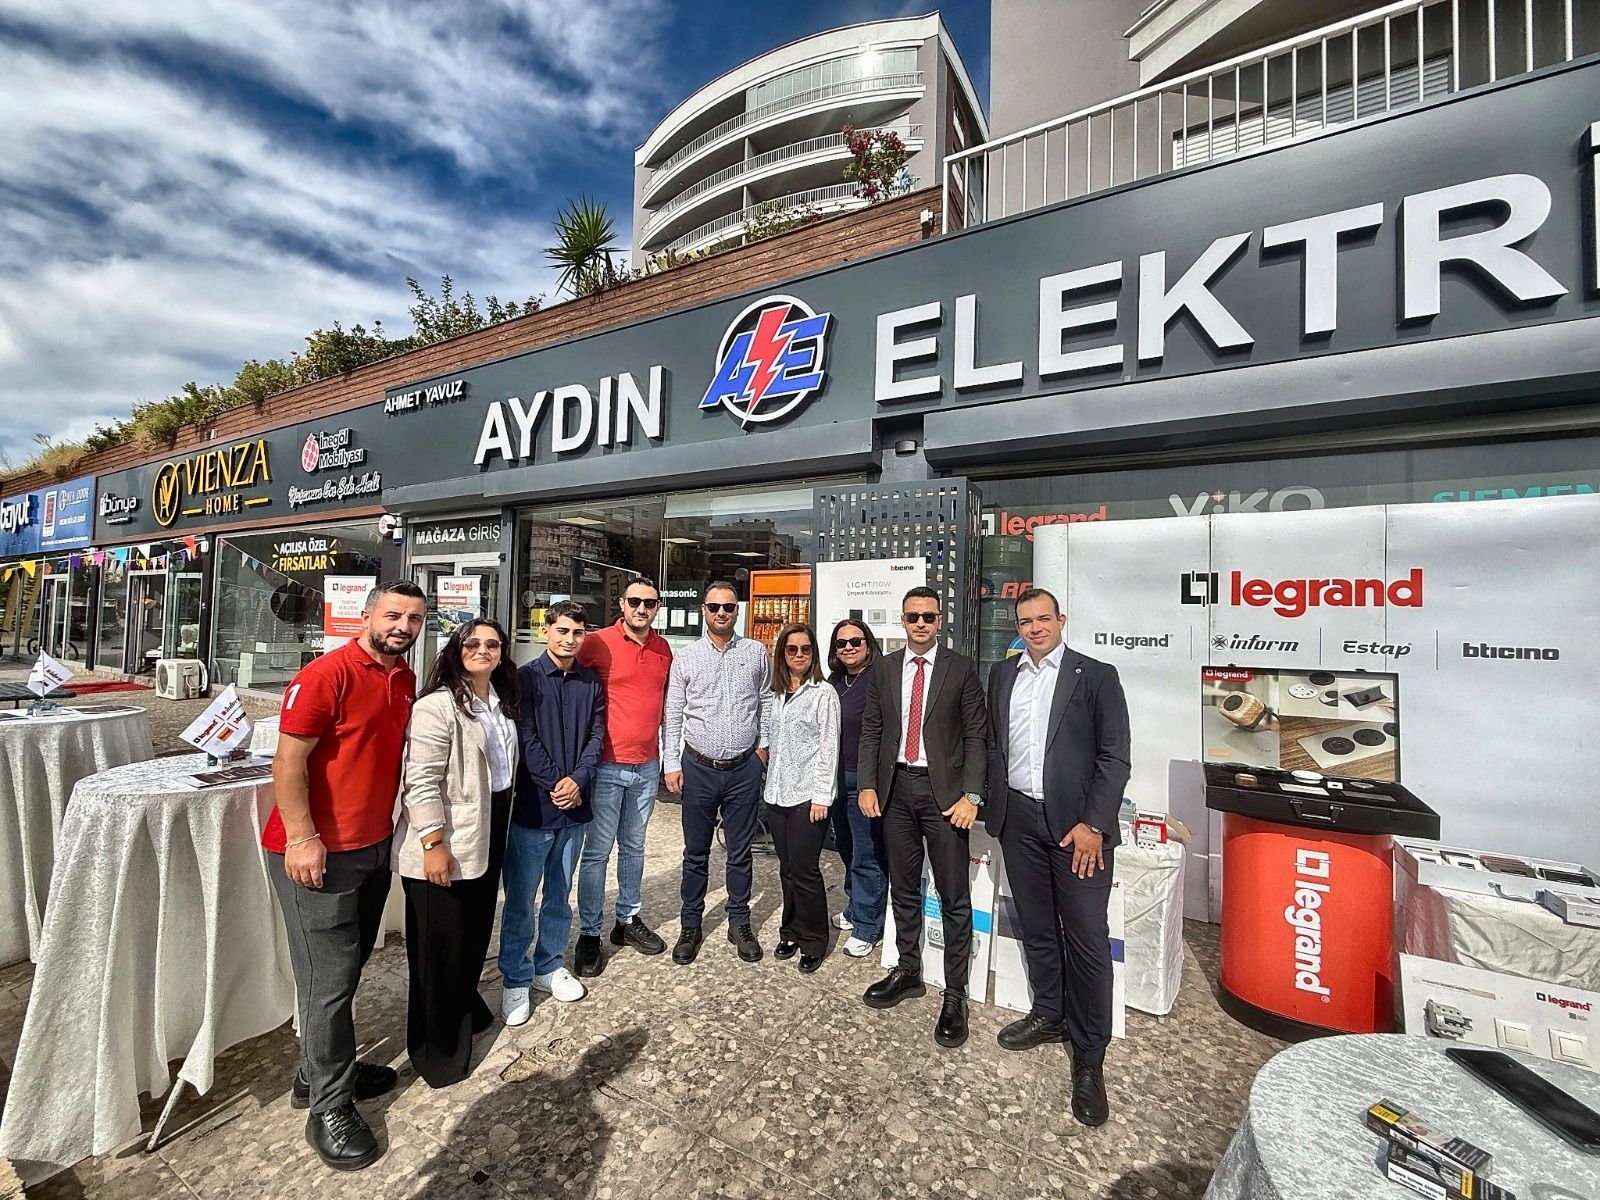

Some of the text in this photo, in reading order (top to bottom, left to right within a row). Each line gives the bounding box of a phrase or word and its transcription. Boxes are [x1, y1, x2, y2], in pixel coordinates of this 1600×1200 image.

[384, 380, 464, 414] AHMET YAVUZ
[473, 365, 664, 465] AYDIN
[319, 428, 349, 450] İnegöl
[185, 439, 270, 495] VIENZA
[318, 448, 364, 469] Mobilyası
[205, 494, 239, 515] HOME
[416, 523, 500, 544] MAĞAZA GİRİŞ
[280, 537, 328, 556] AÇILIŞA ÖZEL
[279, 554, 328, 571] FIRSATLAR
[339, 583, 367, 593] legrand
[449, 582, 473, 593] legrand
[660, 588, 698, 598] anasonic
[1230, 568, 1424, 618] legrand
[1110, 633, 1169, 650] legrand
[1229, 633, 1299, 652] inform
[1343, 640, 1411, 659] Estap
[1462, 642, 1560, 661] bticino
[1214, 671, 1248, 679] legrand
[286, 683, 301, 710] 1
[1284, 880, 1331, 996] legrand
[1548, 994, 1591, 1012] legrand
